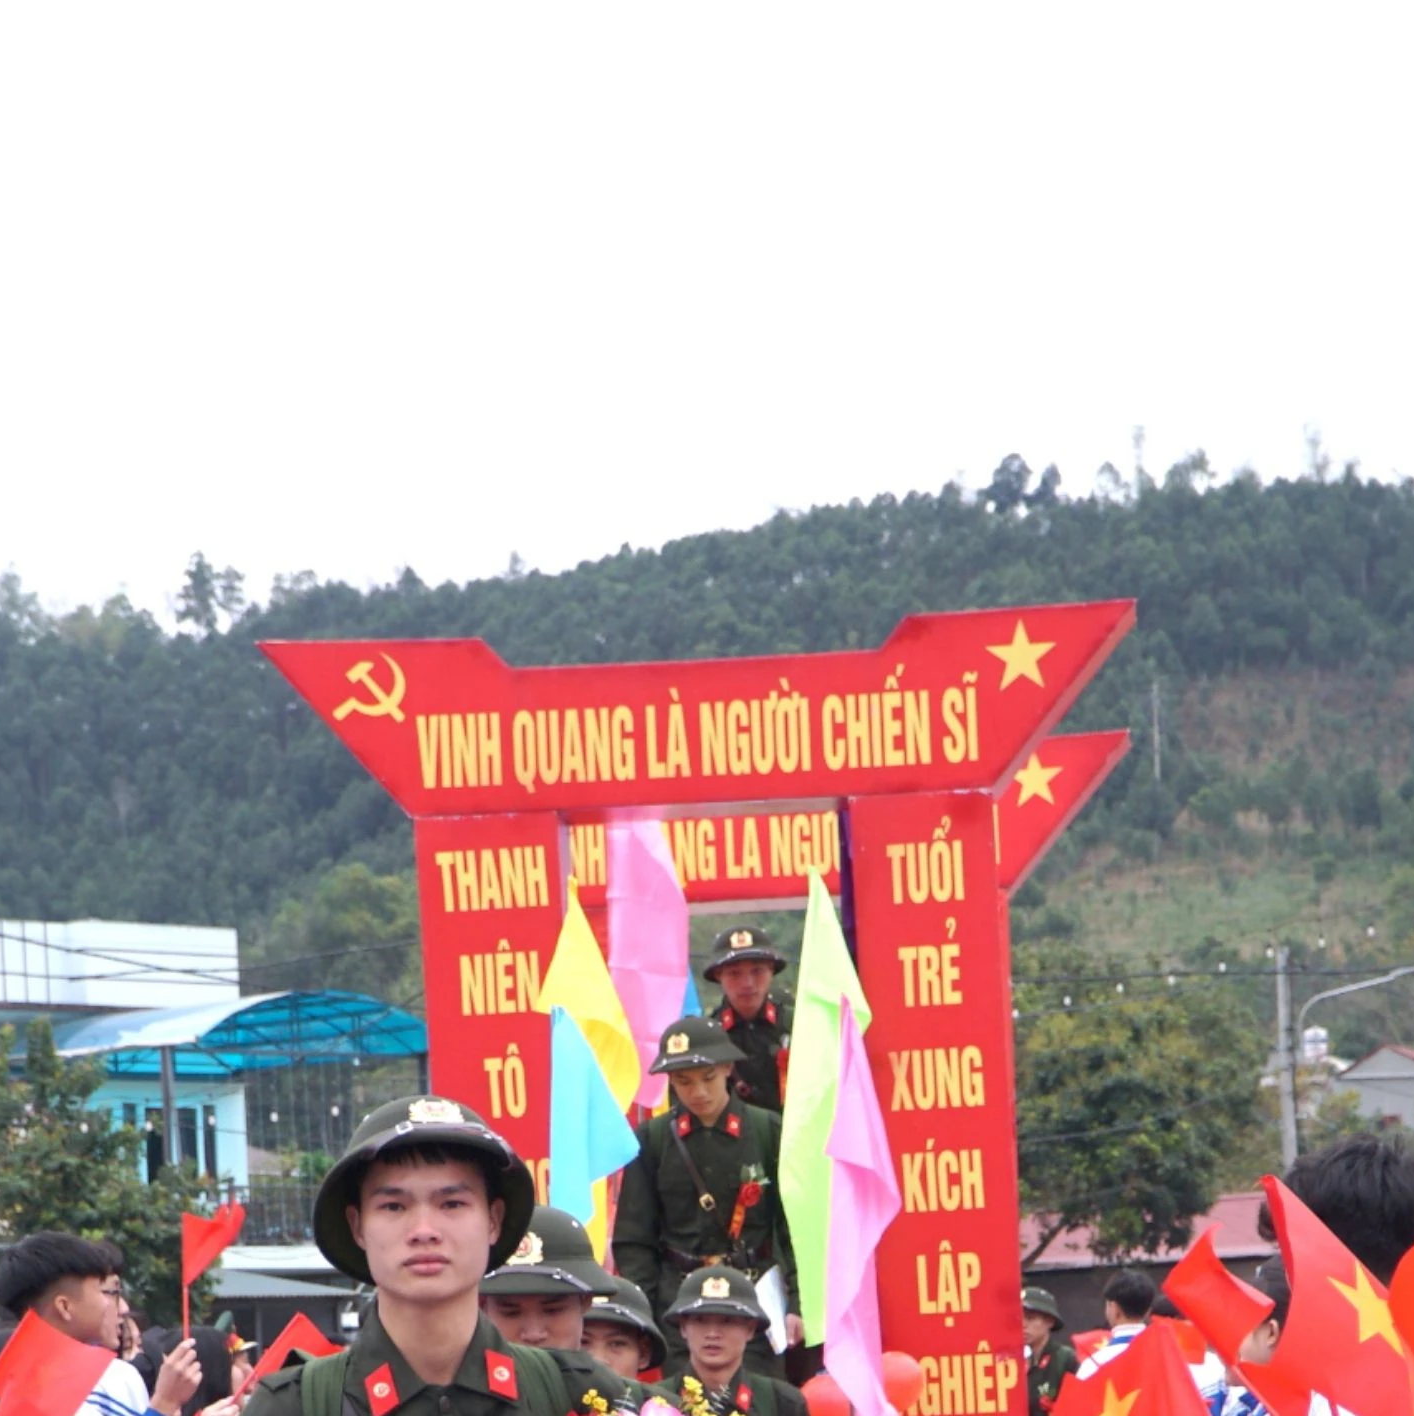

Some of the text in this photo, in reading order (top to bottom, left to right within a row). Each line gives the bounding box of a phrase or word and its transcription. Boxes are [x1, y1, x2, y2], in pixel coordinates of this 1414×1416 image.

[416, 663, 979, 792] VINH QUANG LÀ NGƯỜI CHIẾN SĨ
[435, 845, 549, 913] THANH
[886, 815, 965, 904] TUỔI
[459, 938, 540, 1016] NIÊN
[898, 917, 963, 1008] TRẺ
[483, 1043, 527, 1118] TÔ
[889, 1045, 985, 1111] XUNG
[902, 1138, 985, 1213] KÍCH
[916, 1240, 981, 1327] LẬP
